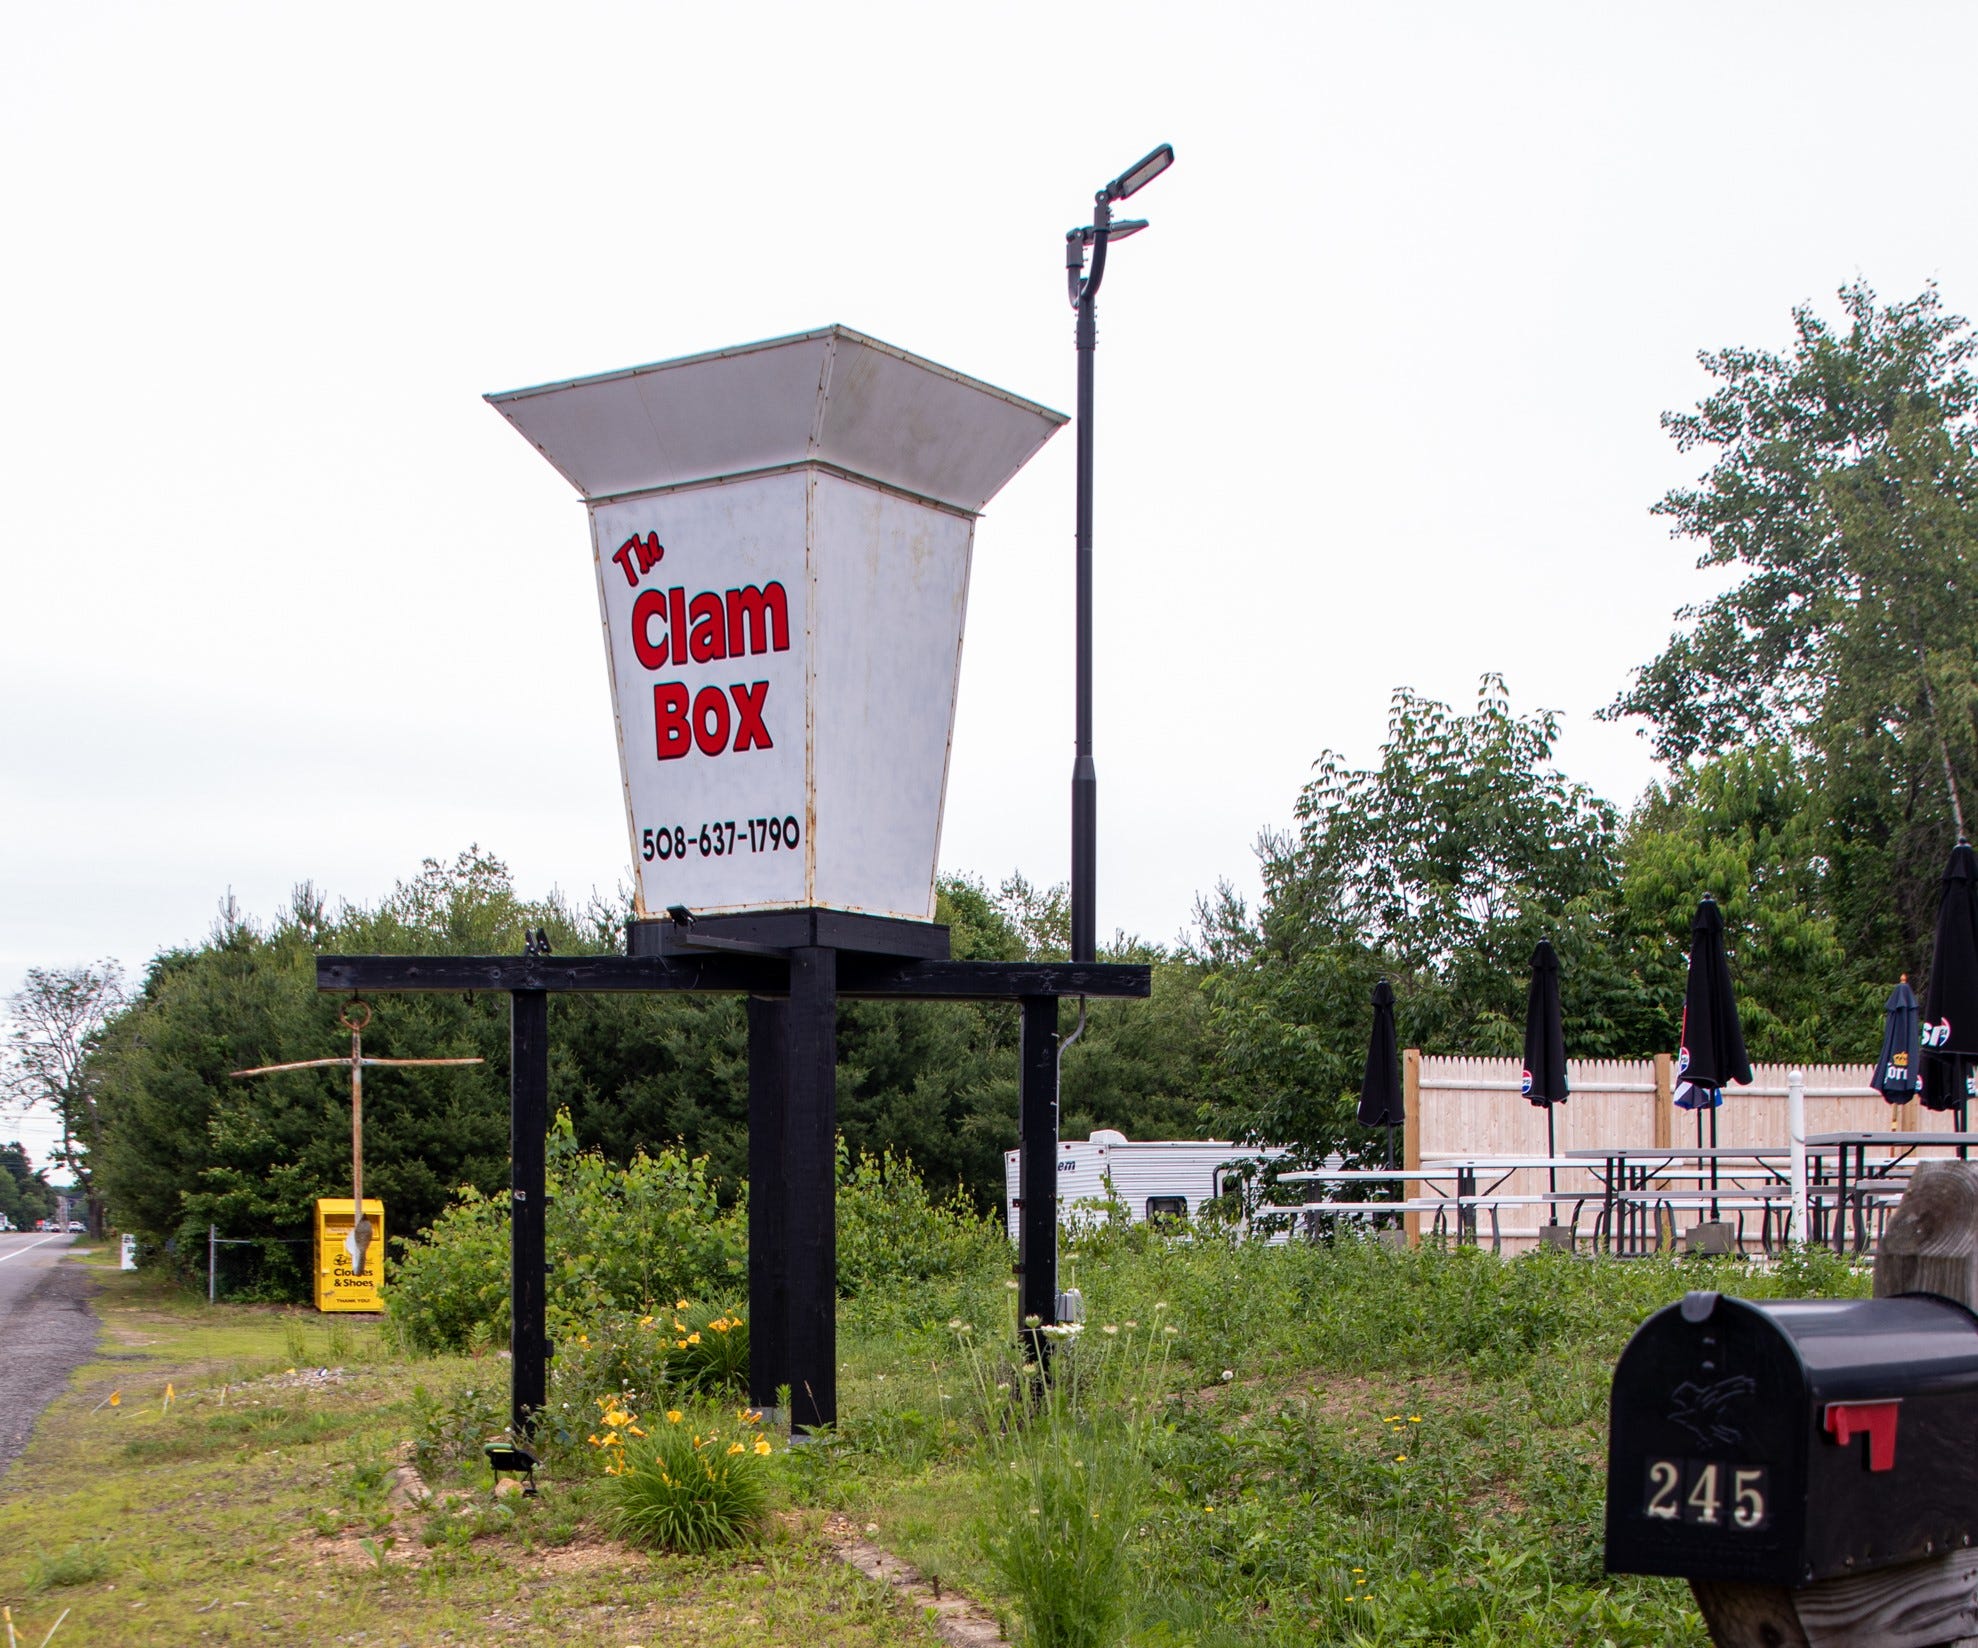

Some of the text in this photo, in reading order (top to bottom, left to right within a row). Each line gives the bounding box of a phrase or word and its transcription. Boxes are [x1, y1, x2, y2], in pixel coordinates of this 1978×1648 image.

[612, 530, 665, 587] The
[631, 580, 791, 671] Clam
[653, 680, 774, 762] BOX
[642, 815, 800, 862] 508-637-1790
[334, 1278, 374, 1287] & Shoes
[1647, 1461, 1764, 1529] 245
